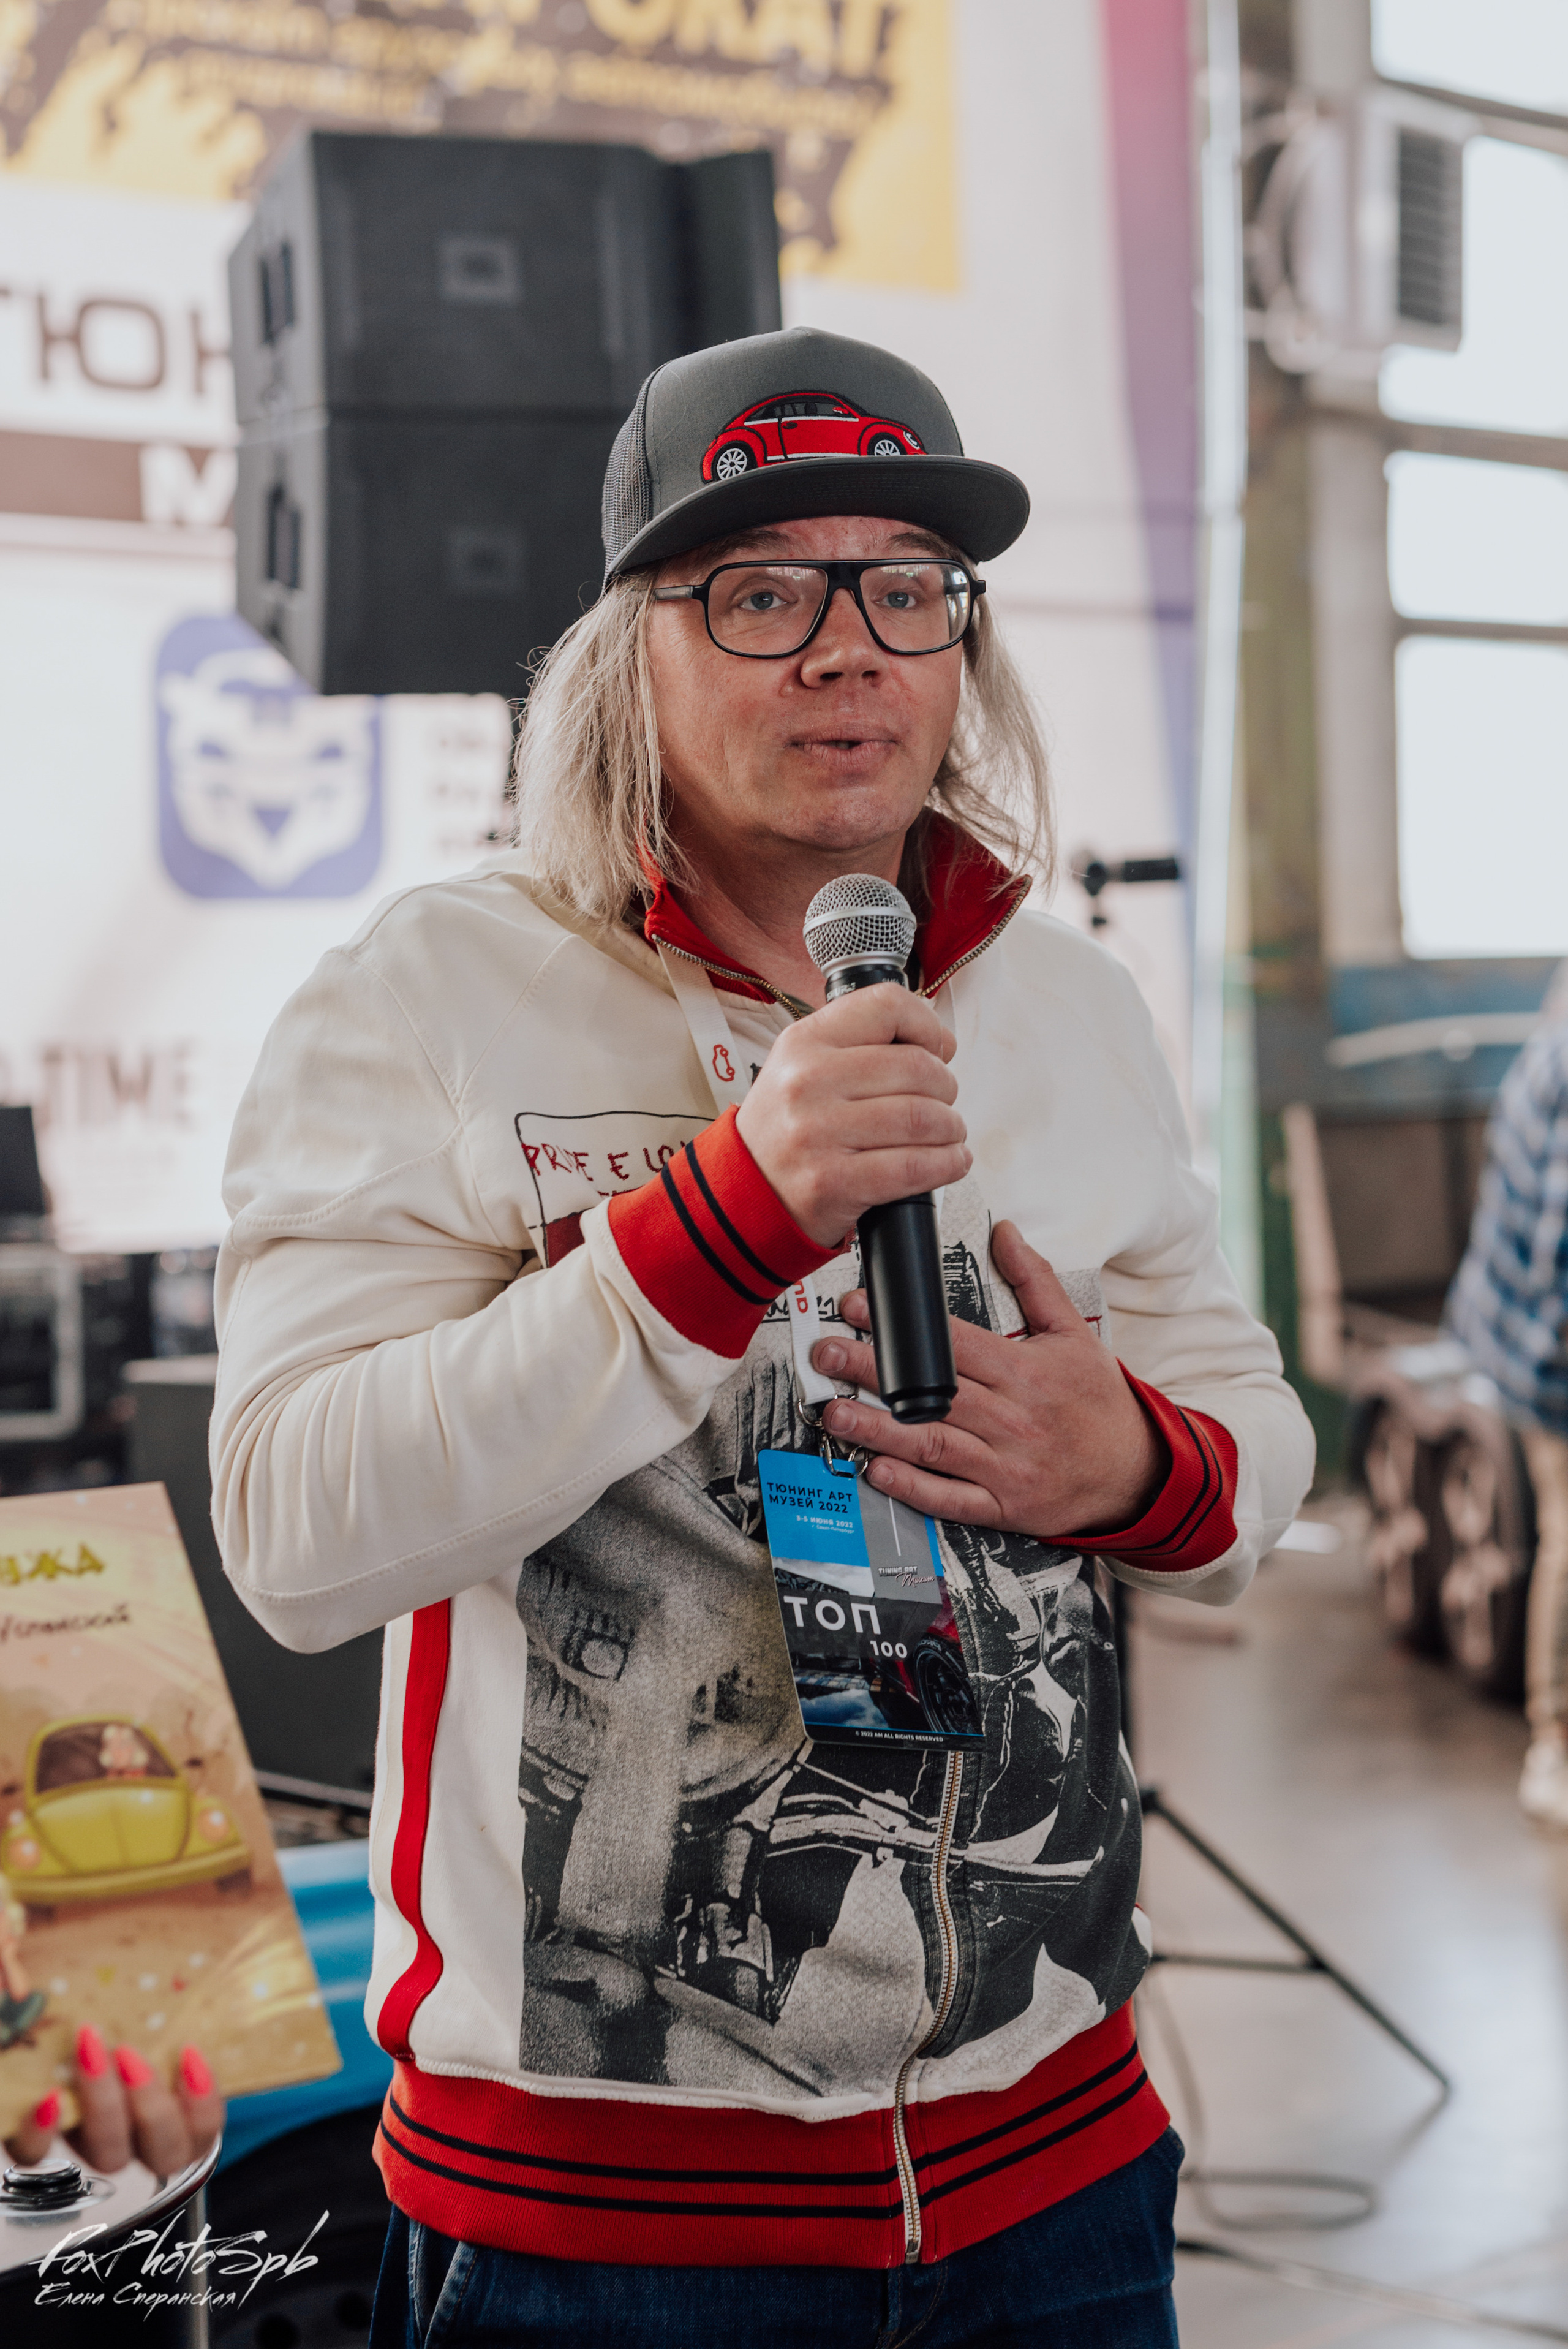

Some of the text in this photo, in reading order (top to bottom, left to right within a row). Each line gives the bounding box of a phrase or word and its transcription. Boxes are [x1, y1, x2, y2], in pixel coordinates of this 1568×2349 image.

[766, 1482, 853, 1502] ТЮНИНГ АРТ
[769, 1494, 848, 1513] МУЗЕЙ 2022
[836, 1519, 853, 1529] 2022
[878, 1567, 903, 1577] TUNING
[783, 1595, 881, 1635] ТОП
[870, 1640, 908, 1659] 100
